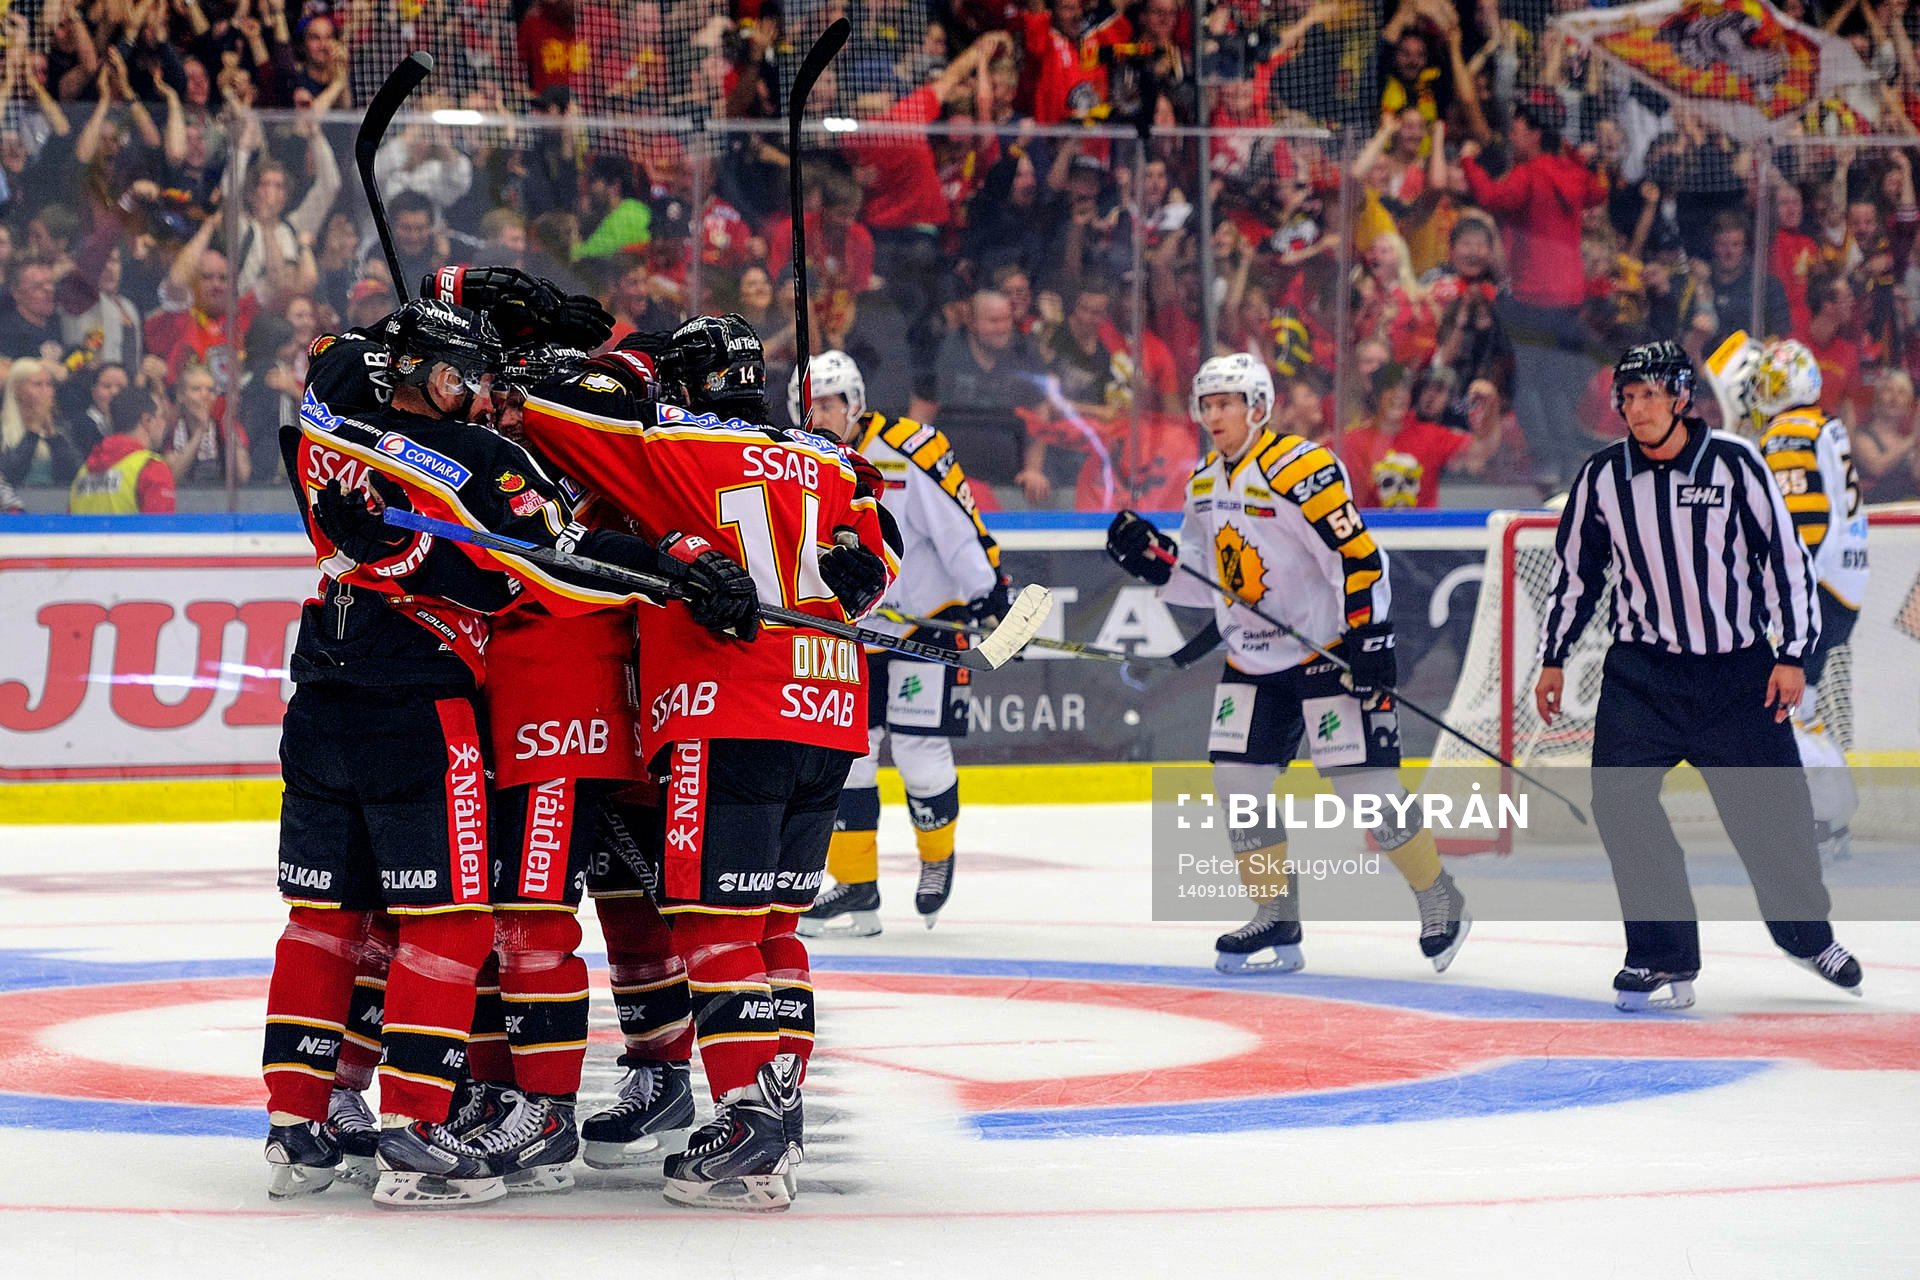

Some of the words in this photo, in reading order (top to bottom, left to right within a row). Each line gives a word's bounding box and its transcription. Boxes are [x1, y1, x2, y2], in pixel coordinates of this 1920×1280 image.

[739, 366, 755, 385] 14
[344, 418, 384, 437] BAUER
[405, 448, 460, 483] CORVARA
[742, 445, 820, 491] SSAB
[1680, 486, 1722, 504] SHL
[1325, 502, 1364, 540] 54
[374, 531, 433, 577] AUER
[416, 610, 457, 640] BAUER
[793, 635, 861, 685] DIXON
[651, 681, 718, 733] SSAB
[780, 684, 855, 728] SSAB
[515, 718, 609, 760] SSAB
[287, 864, 332, 890] LKAB
[391, 869, 437, 889] LKAB
[739, 1000, 774, 1020] NEX
[296, 1035, 341, 1058] NEX
